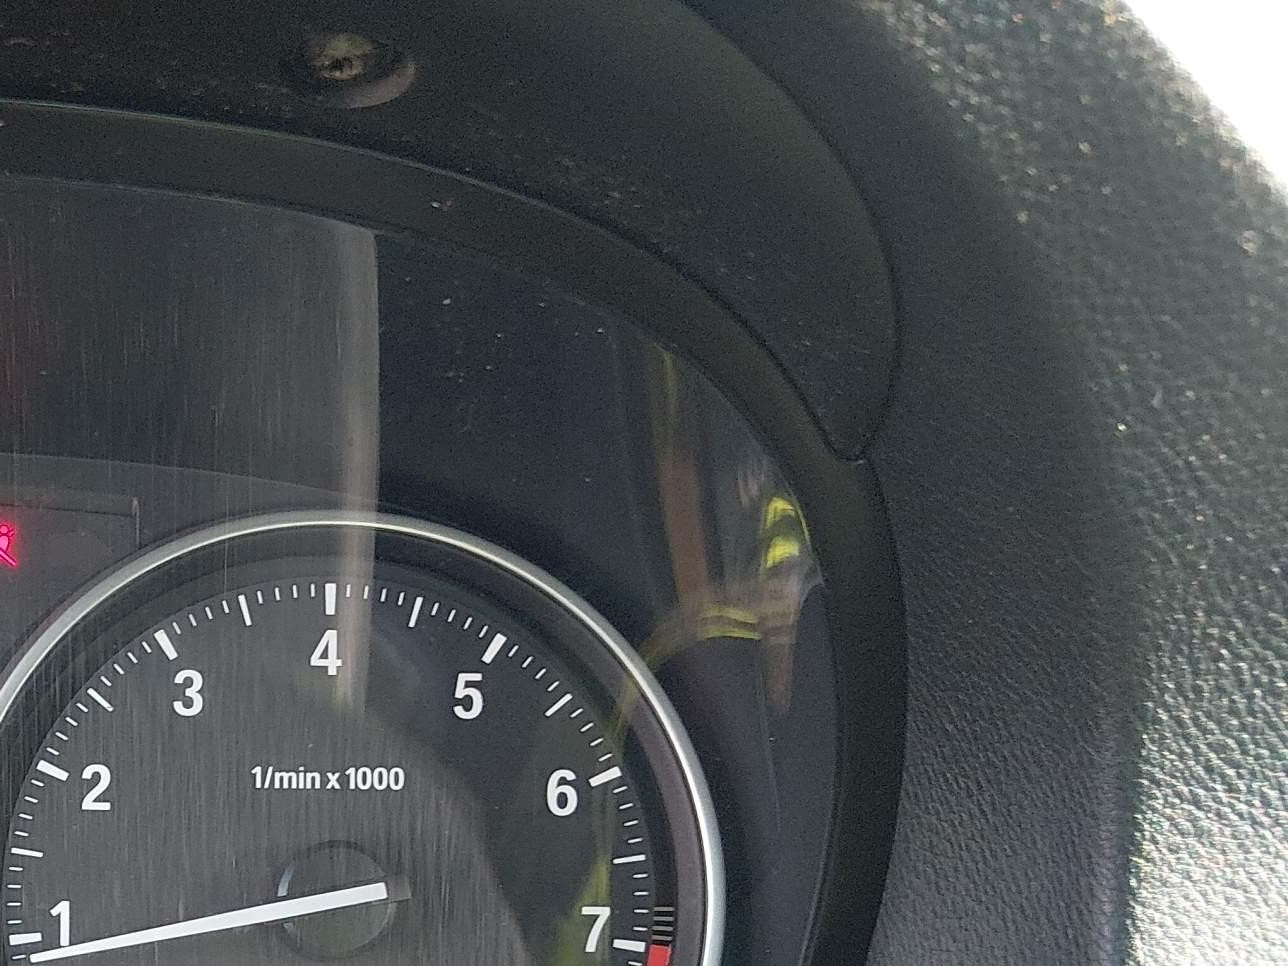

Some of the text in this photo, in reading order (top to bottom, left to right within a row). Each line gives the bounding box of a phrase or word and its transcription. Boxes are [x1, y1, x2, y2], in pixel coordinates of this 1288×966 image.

[310, 630, 342, 675] 4
[173, 670, 204, 716] 3
[453, 673, 484, 719] 5
[81, 764, 112, 811] 2
[546, 769, 579, 816] 6
[49, 900, 71, 946] 1
[581, 906, 611, 953] 7
